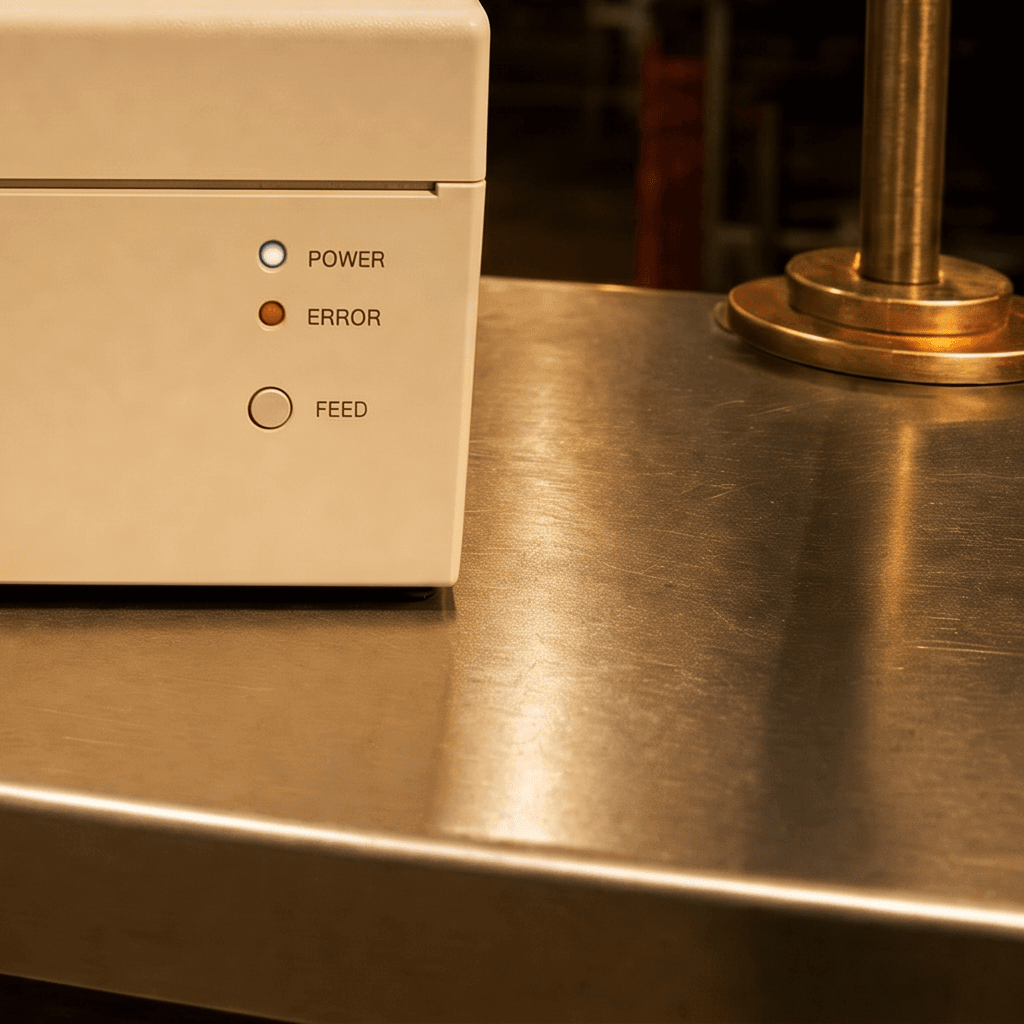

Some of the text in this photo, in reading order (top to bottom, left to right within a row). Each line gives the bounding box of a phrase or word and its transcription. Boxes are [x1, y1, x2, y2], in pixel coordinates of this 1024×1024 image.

[308, 249, 385, 268] POWER
[307, 308, 381, 326] ERROR
[316, 400, 368, 418] FEED
